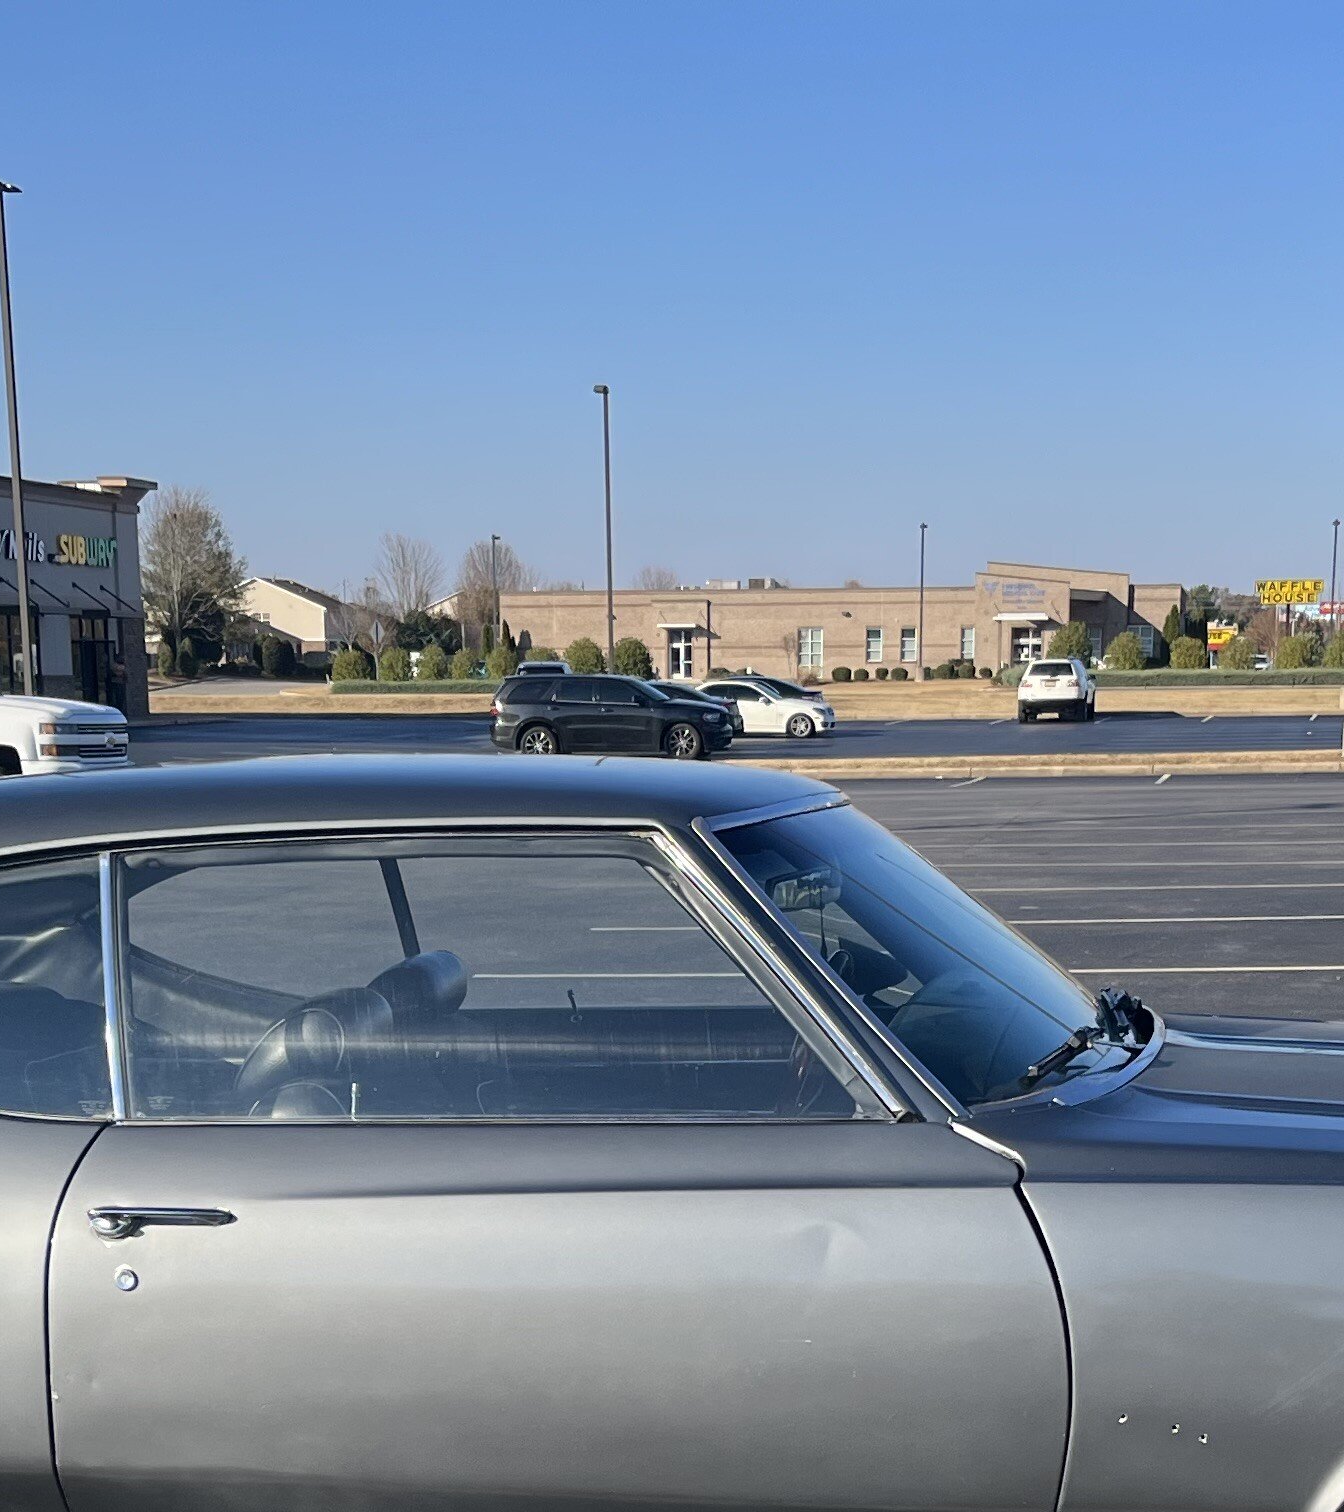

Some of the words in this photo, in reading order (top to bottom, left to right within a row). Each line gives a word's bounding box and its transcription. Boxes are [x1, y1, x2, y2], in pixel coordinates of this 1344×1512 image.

[54, 534, 116, 567] SUBWAY
[1257, 581, 1323, 593] WAFFLE
[1262, 593, 1316, 603] HOUSE
